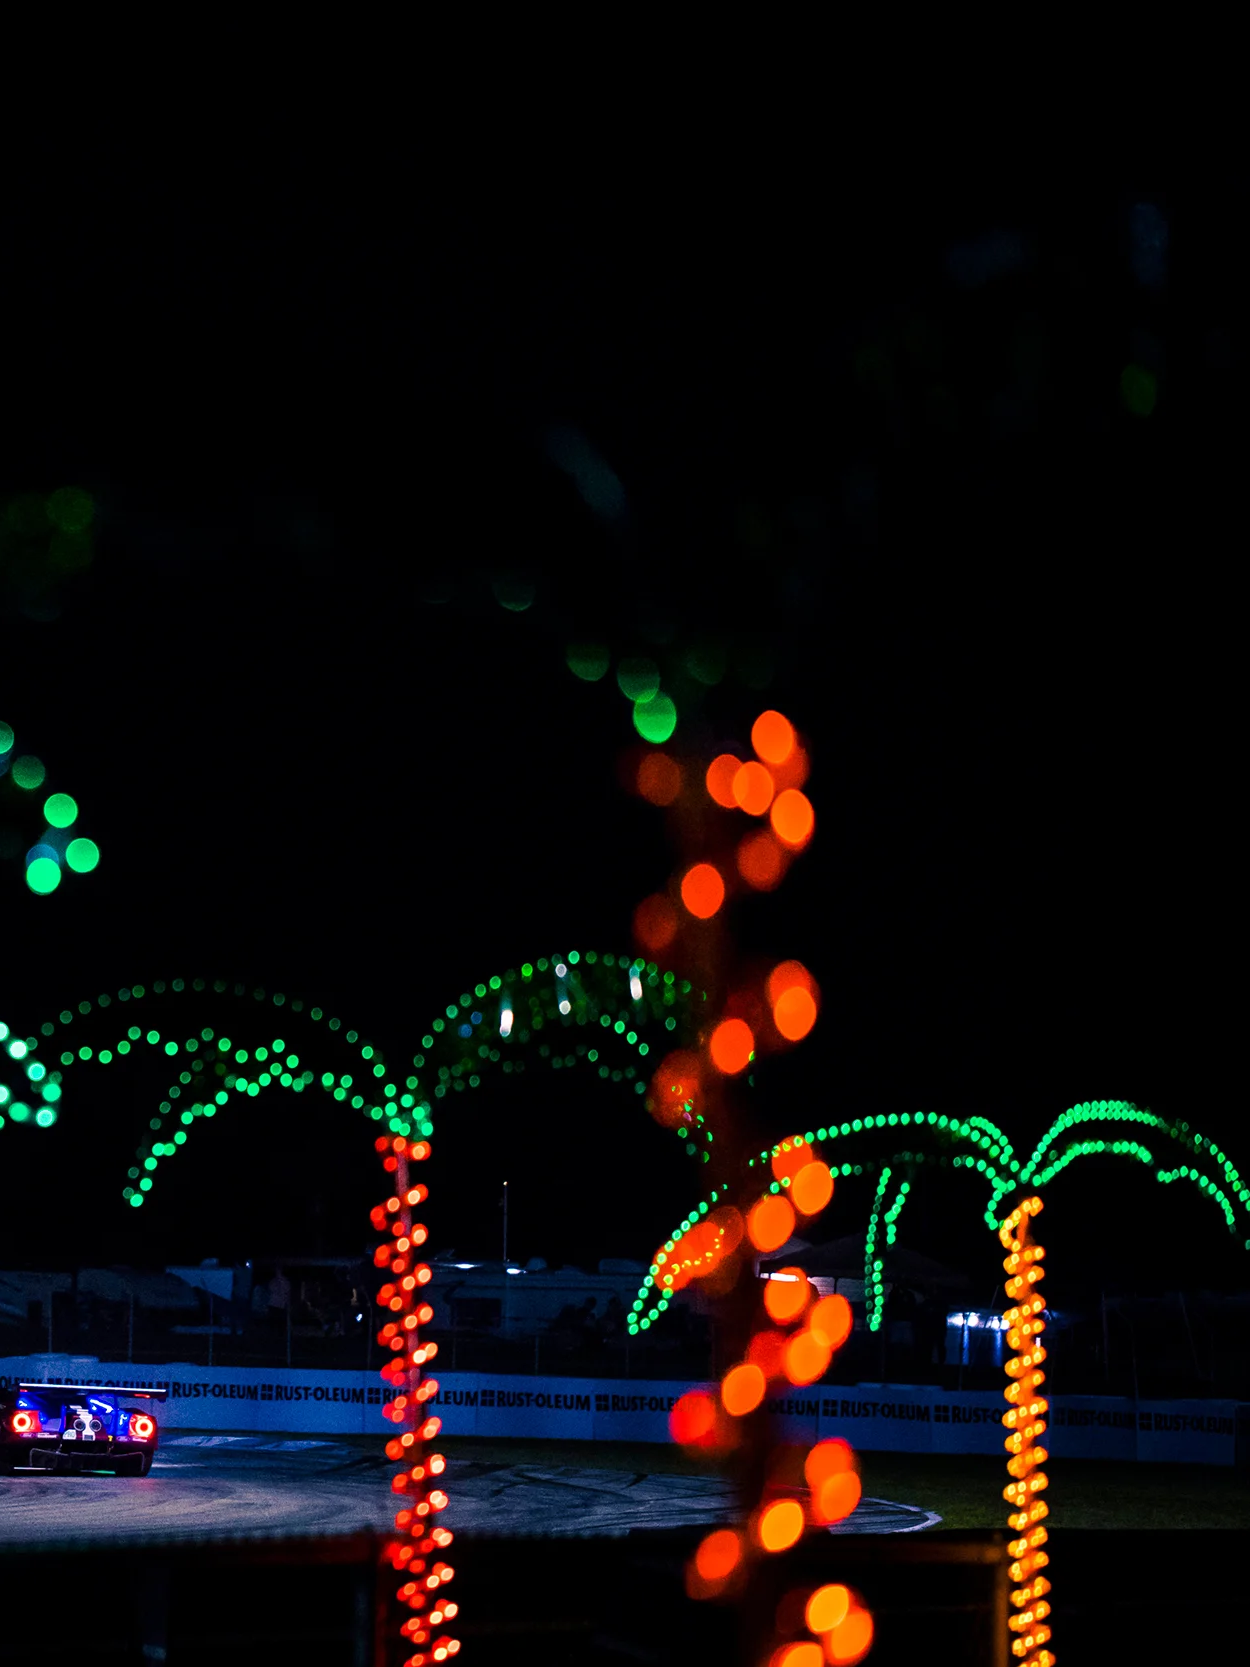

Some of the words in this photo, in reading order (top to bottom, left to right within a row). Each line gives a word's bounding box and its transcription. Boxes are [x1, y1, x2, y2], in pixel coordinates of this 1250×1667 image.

[172, 1382, 259, 1400] RUST-OLEUM
[275, 1384, 365, 1403] RUST-OLEUM
[497, 1390, 590, 1411] RUST-OLEUM
[612, 1394, 678, 1411] RUST-OLE
[841, 1401, 930, 1421] RUST-OLEUM
[952, 1406, 1007, 1424] RUST-O
